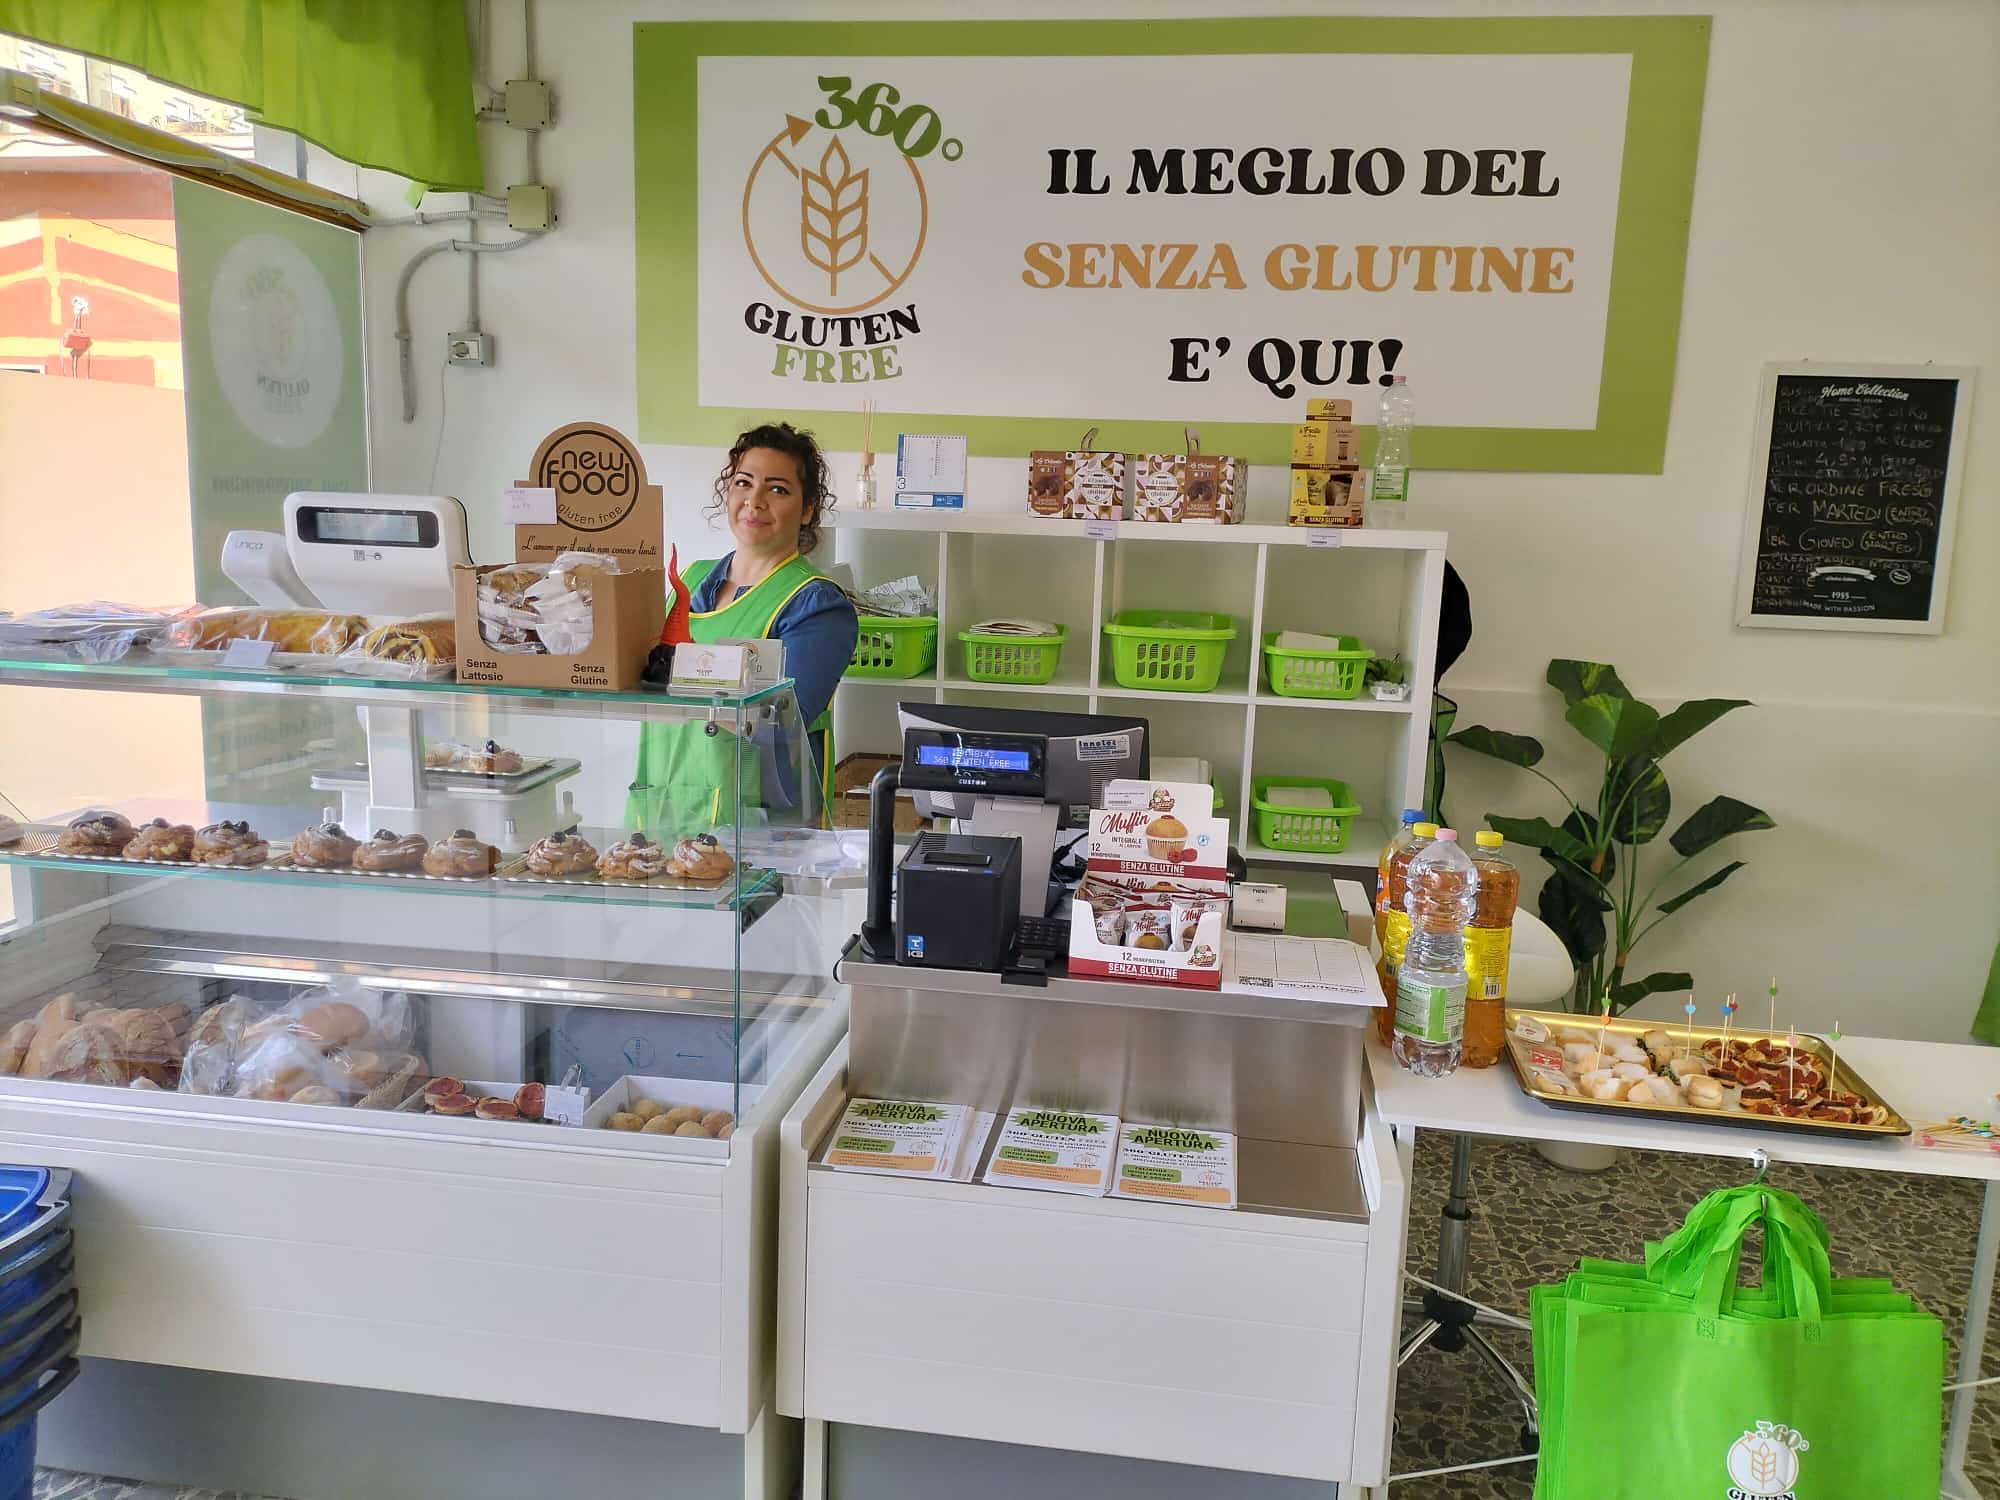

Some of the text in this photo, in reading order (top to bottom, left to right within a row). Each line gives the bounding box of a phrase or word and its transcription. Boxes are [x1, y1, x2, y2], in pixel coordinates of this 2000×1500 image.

[1047, 147, 1560, 197] IL MEGLIO DEL
[1022, 242, 1575, 293] SENZA GLUTINE
[745, 302, 921, 347] GLUTEN
[771, 344, 903, 383] FREE
[1247, 338, 1403, 399] QUI!
[1821, 383, 1853, 399] Home
[1855, 383, 1910, 401] Collection
[561, 450, 625, 471] new
[546, 459, 630, 497] food
[1805, 483, 1865, 497] ORDINE
[558, 503, 624, 525] gluten free
[611, 546, 636, 555] conosce
[638, 539, 657, 556] limiti
[466, 658, 498, 669] Senza
[573, 663, 605, 674] Senza
[461, 671, 504, 682] Lattosio
[570, 675, 609, 686] Glutine
[988, 758, 1011, 769] FREE
[958, 778, 987, 786] CUSTOM
[1100, 811, 1150, 834] Muffin
[1092, 842, 1102, 852] 12
[1111, 836, 1142, 846] INTEGRALE
[1120, 860, 1185, 874] SENZA GLUTINE
[1122, 951, 1133, 962] 12
[1108, 962, 1178, 979] SENZA GLUTINE
[860, 1109, 936, 1121] APERTURA
[875, 1103, 926, 1114] NUOVA
[1020, 1118, 1098, 1134] APERTURA
[1036, 1112, 1087, 1126] NUOVA
[1148, 1129, 1200, 1141] NUOVA
[1134, 1135, 1214, 1150] APERTURA
